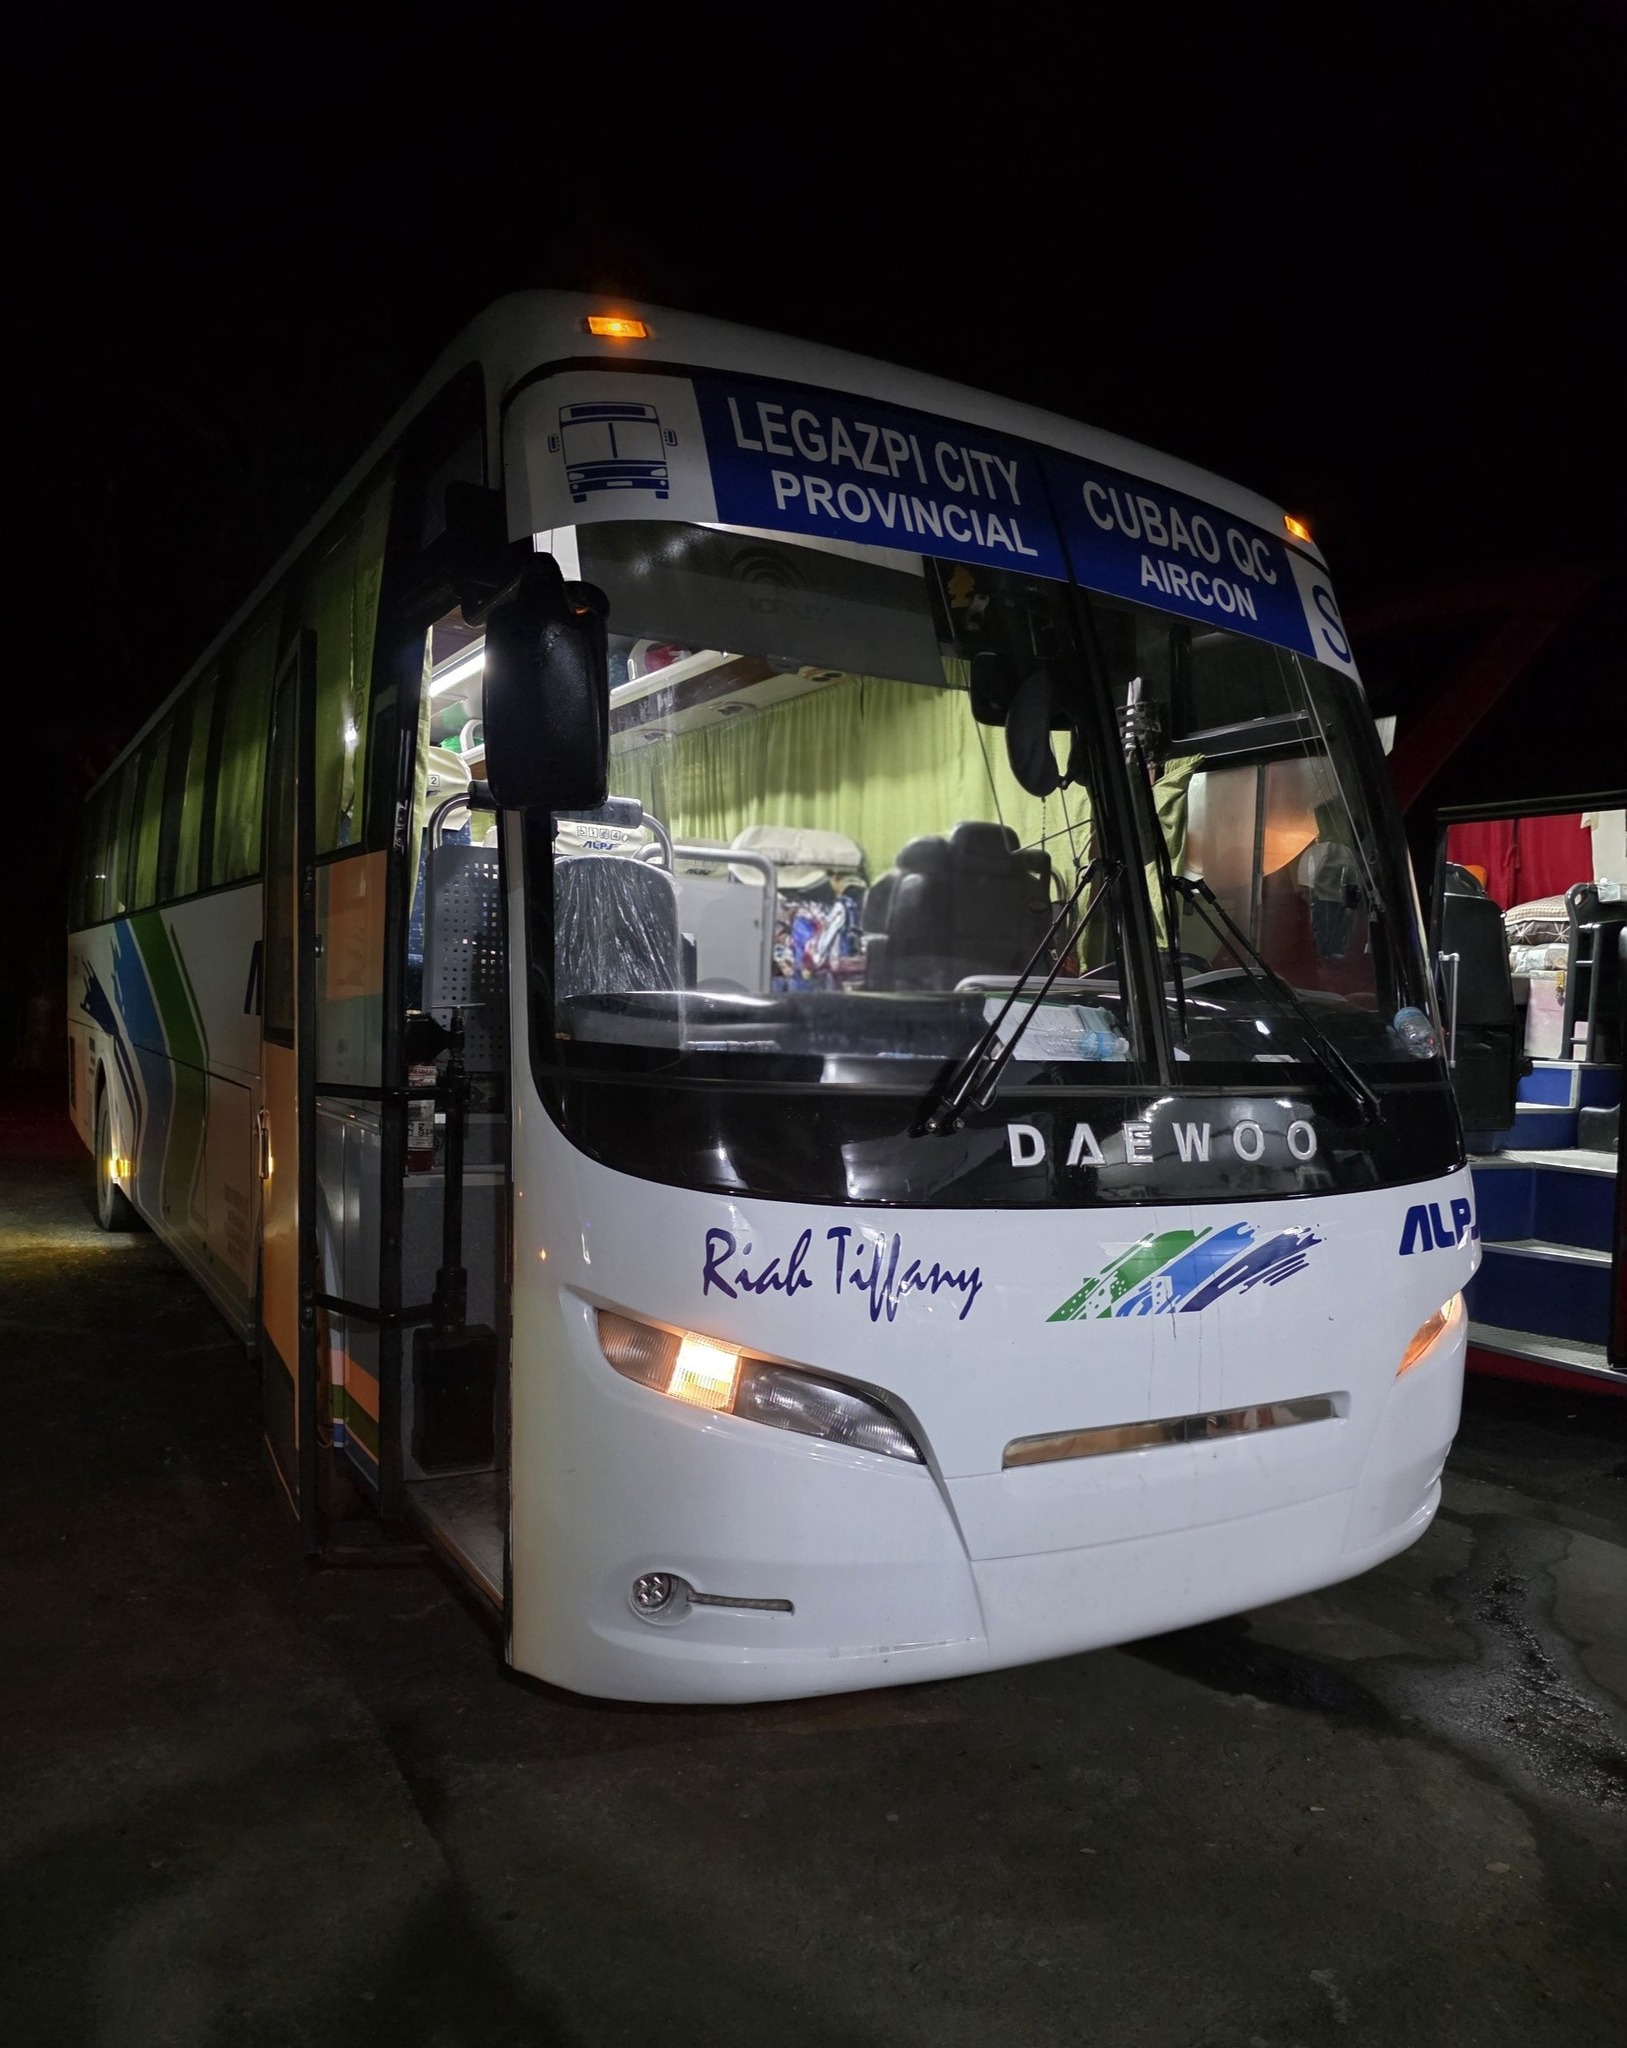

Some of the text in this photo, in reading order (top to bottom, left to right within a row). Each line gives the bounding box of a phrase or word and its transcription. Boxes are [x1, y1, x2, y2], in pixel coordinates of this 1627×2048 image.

[727, 397, 1022, 506] LEGAZPI CITY
[771, 469, 1039, 557] PROVINCIAL
[1083, 480, 1278, 586] CUBAO QC
[1140, 554, 1258, 621] AIRCON
[1006, 1119, 1318, 1168] DAEWOO
[702, 1226, 983, 1322] Riah Tiffany
